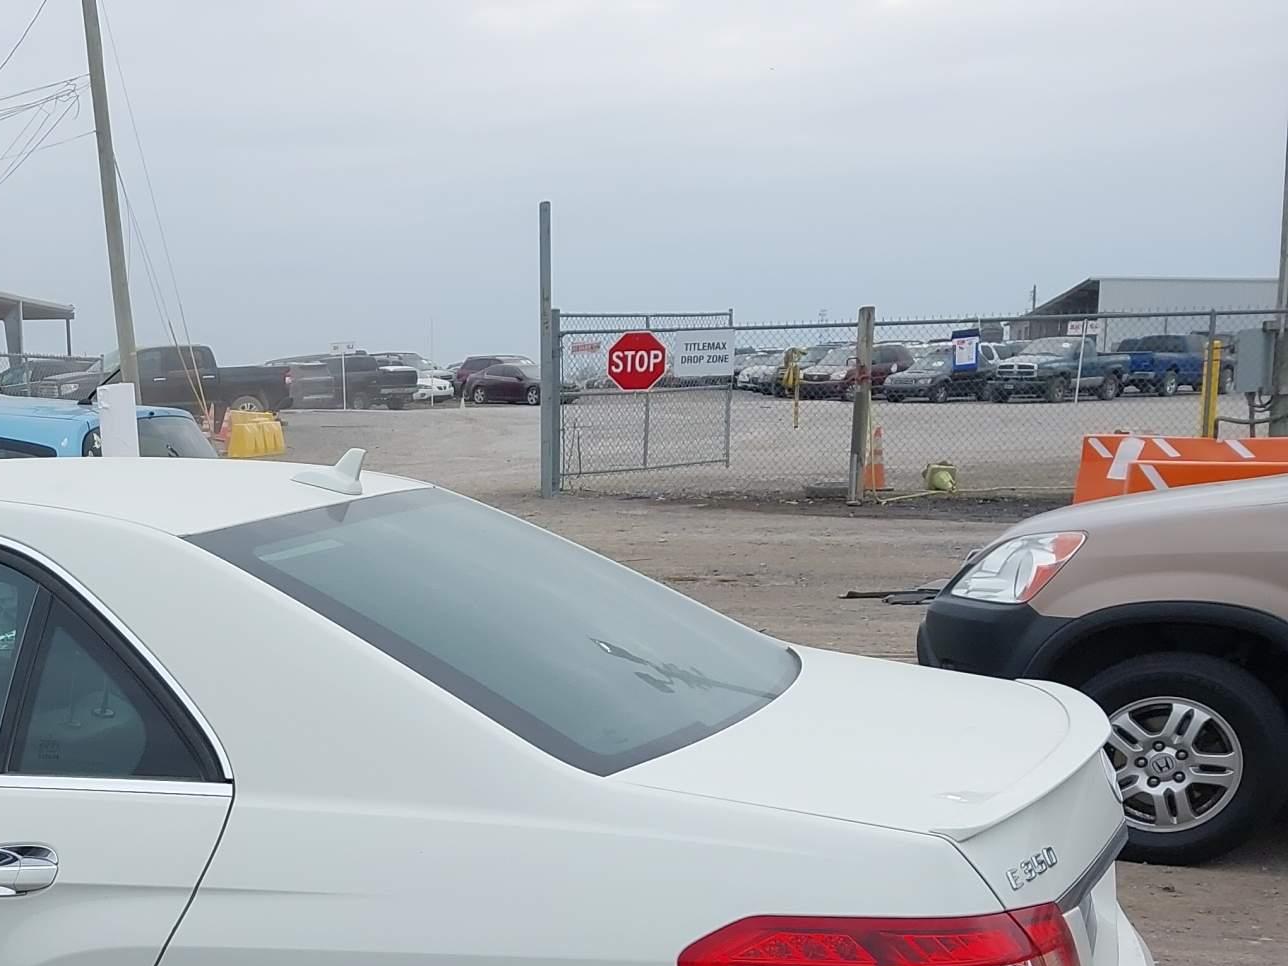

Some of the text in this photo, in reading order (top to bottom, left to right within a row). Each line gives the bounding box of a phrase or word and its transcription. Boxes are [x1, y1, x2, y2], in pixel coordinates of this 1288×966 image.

[684, 342, 727, 351] TITLEMAX
[611, 350, 663, 373] STOP
[680, 354, 729, 364] DROP ZONE
[1006, 846, 1058, 891] E 350
